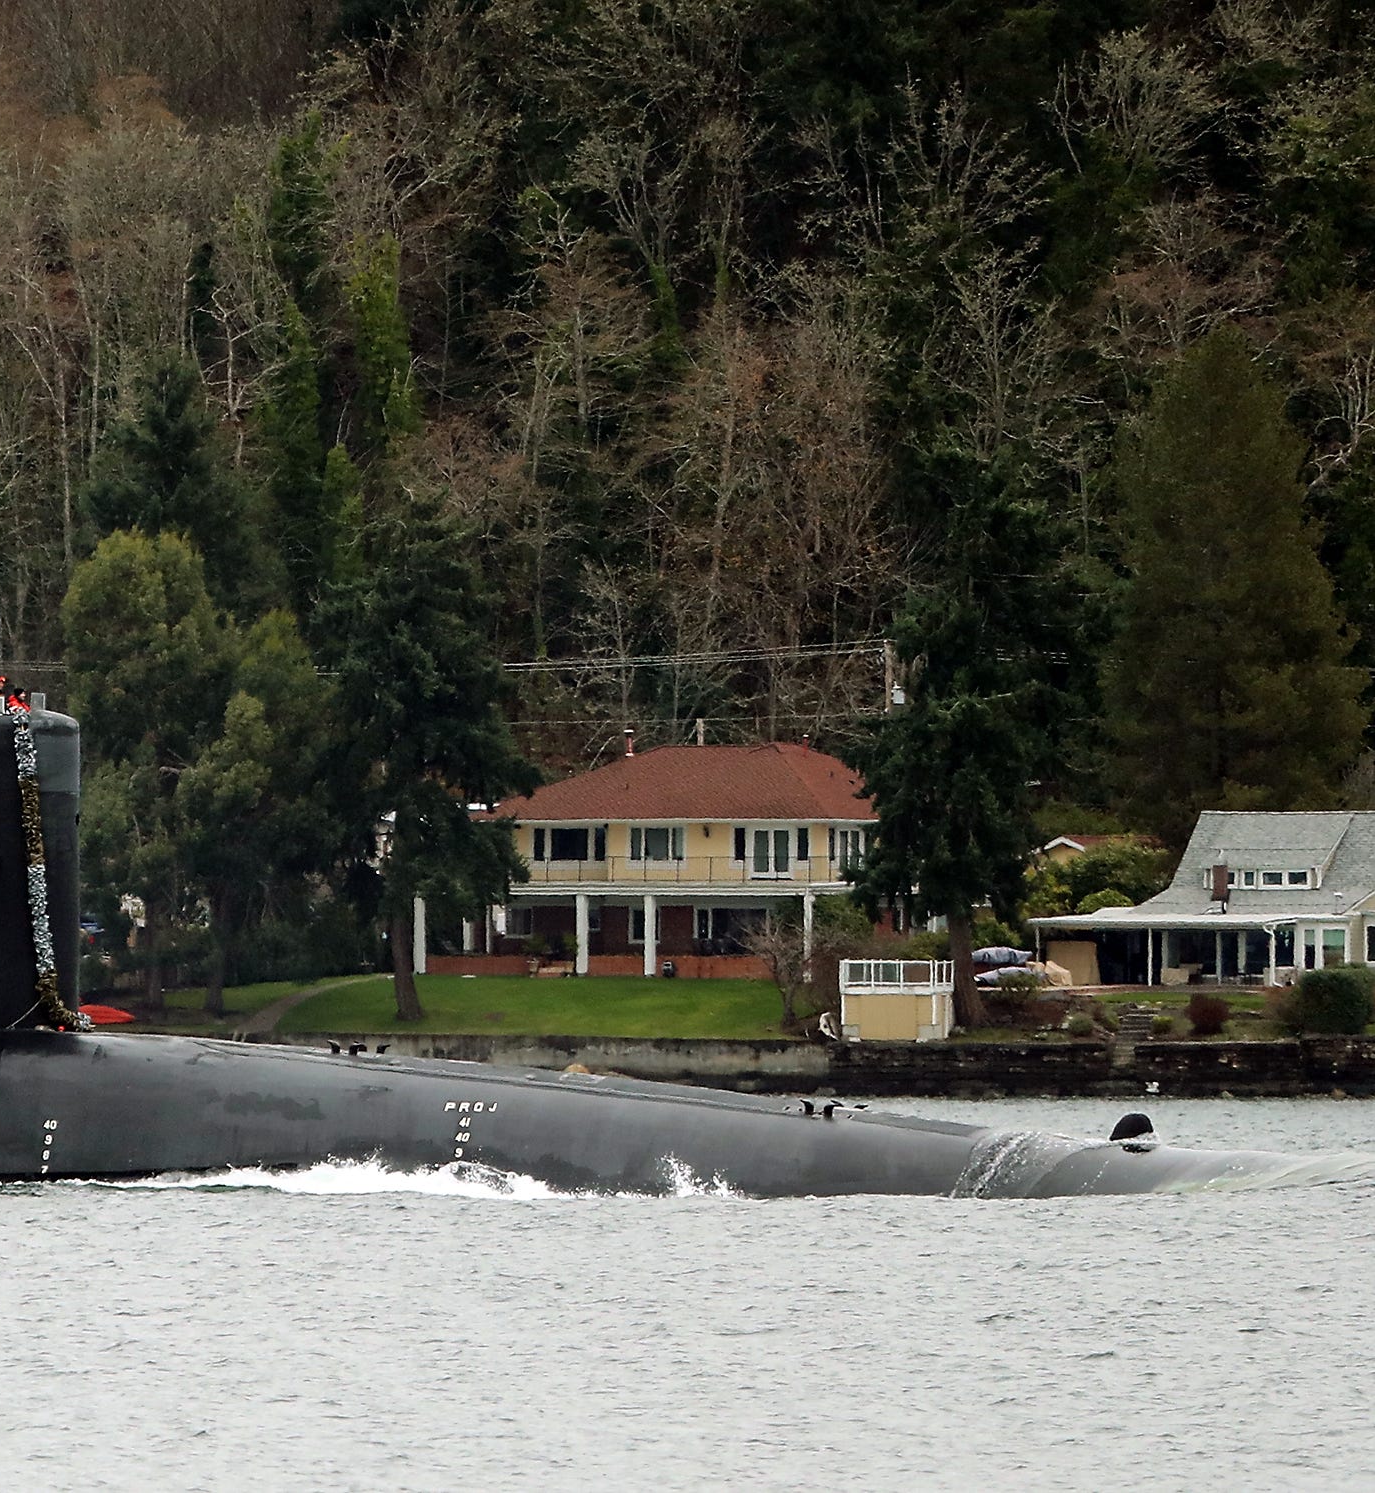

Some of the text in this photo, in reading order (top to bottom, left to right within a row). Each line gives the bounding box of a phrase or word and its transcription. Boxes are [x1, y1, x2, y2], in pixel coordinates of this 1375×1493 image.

[43, 1119, 58, 1131] 40
[458, 1117, 471, 1128] 41
[44, 1134, 53, 1145] 9
[454, 1132, 471, 1142] 40
[42, 1149, 51, 1161] 8
[454, 1147, 464, 1158] 9
[41, 1165, 49, 1174] 7
